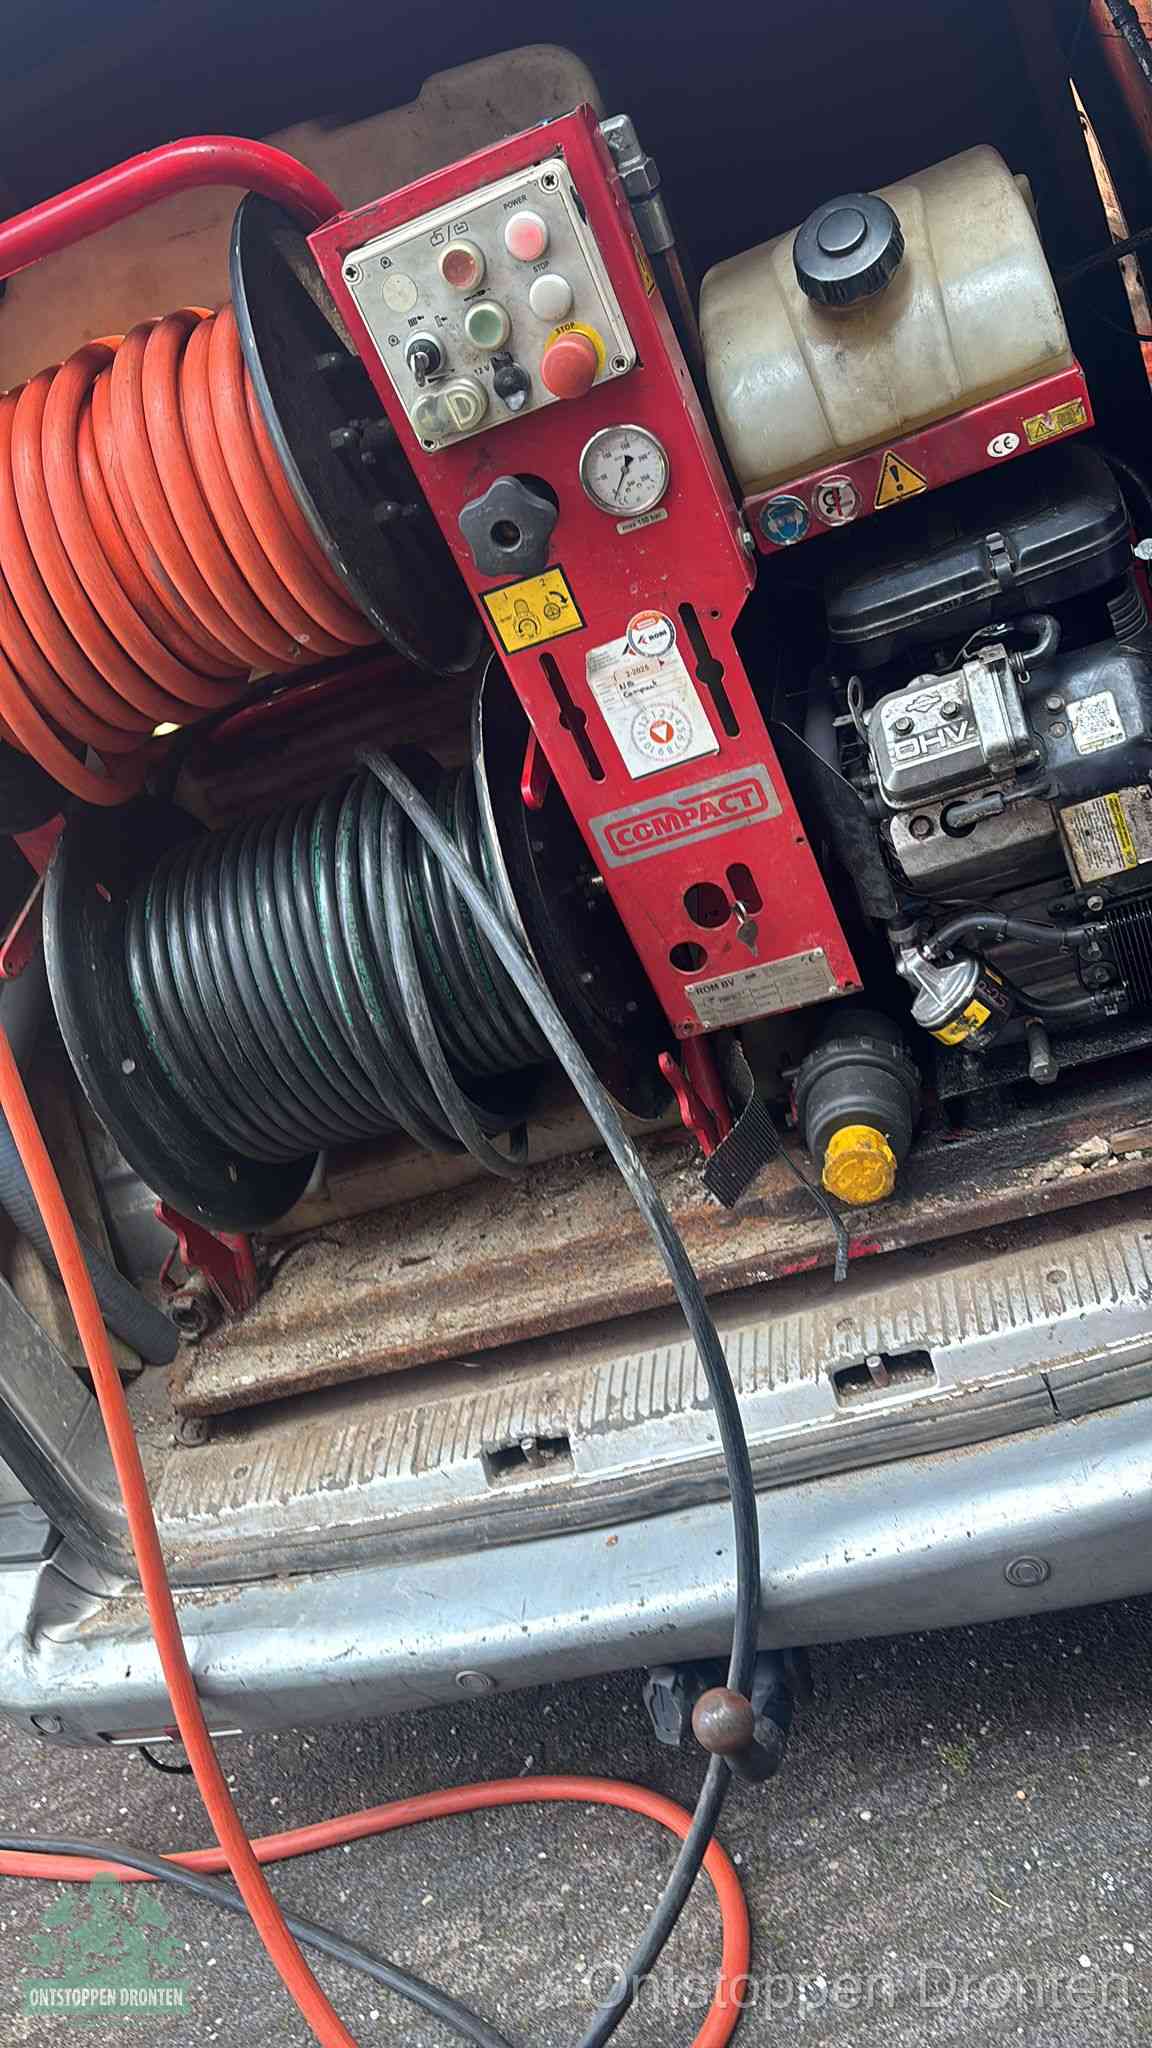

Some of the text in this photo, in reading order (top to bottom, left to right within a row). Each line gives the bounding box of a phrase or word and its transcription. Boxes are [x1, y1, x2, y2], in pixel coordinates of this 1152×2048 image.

[503, 194, 528, 210] POWER
[533, 260, 550, 273] STOP
[554, 322, 576, 334] STOP
[894, 720, 968, 761] OHV
[615, 787, 754, 847] COMPACT
[695, 978, 735, 995] ROM BV
